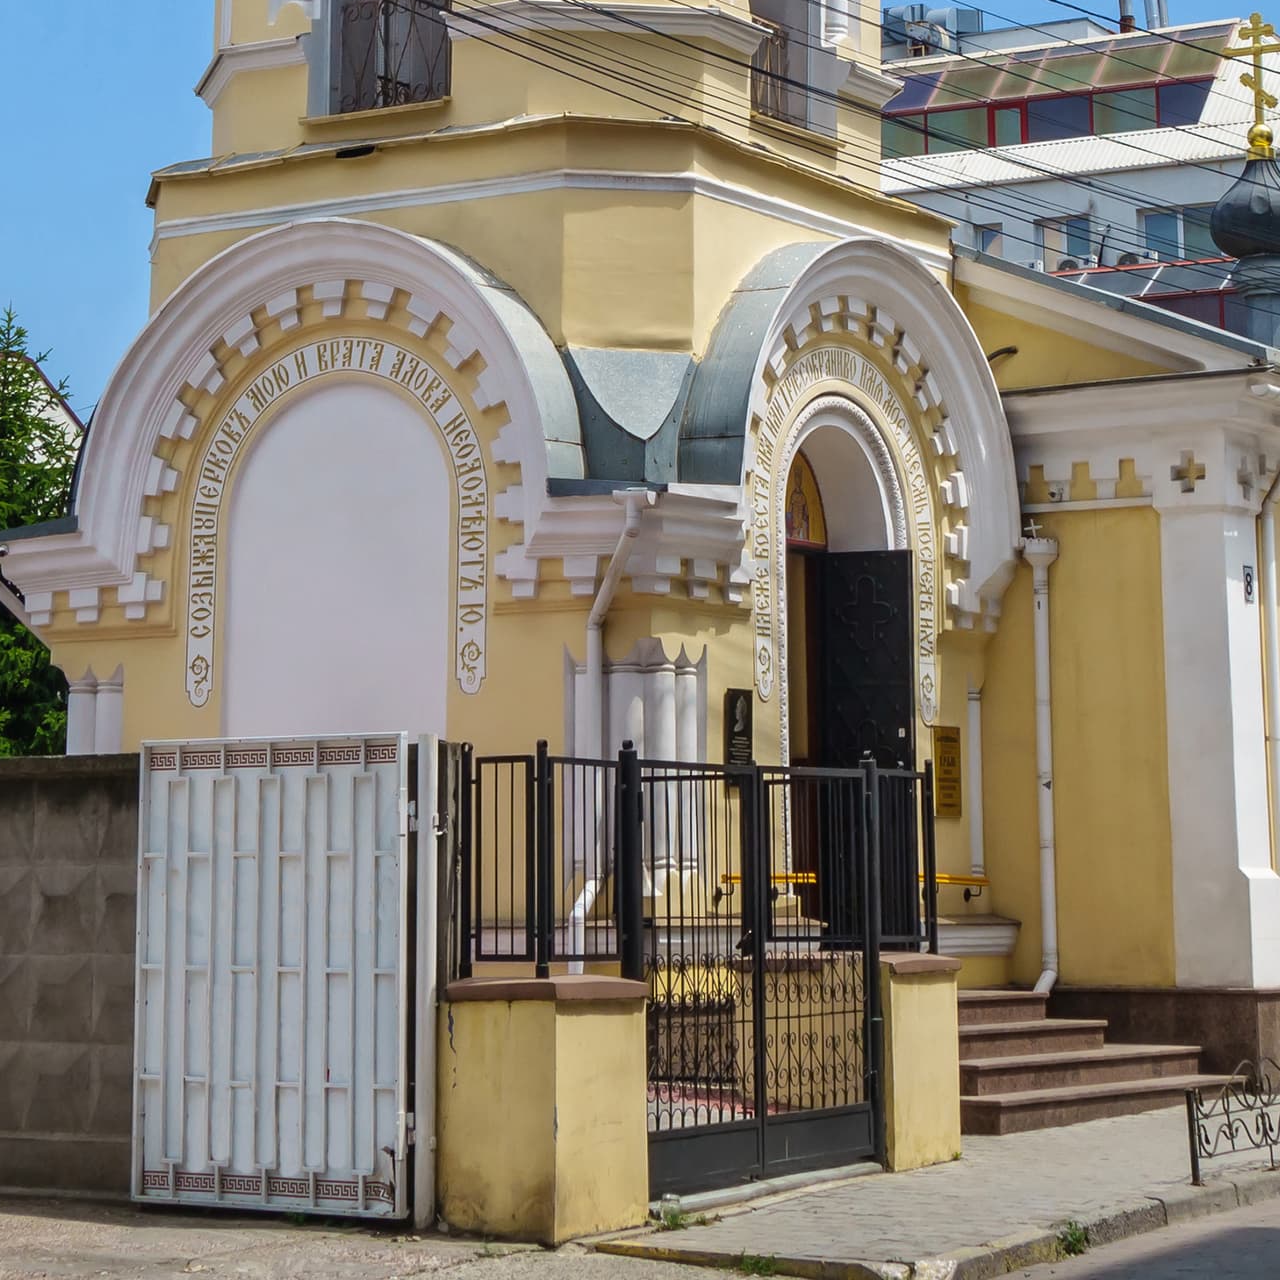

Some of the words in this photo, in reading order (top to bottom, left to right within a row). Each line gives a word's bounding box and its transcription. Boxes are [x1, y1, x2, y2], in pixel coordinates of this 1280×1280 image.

[316, 339, 385, 372] ВРАТА
[389, 350, 452, 414] АДОВА
[1245, 572, 1253, 596] 8
